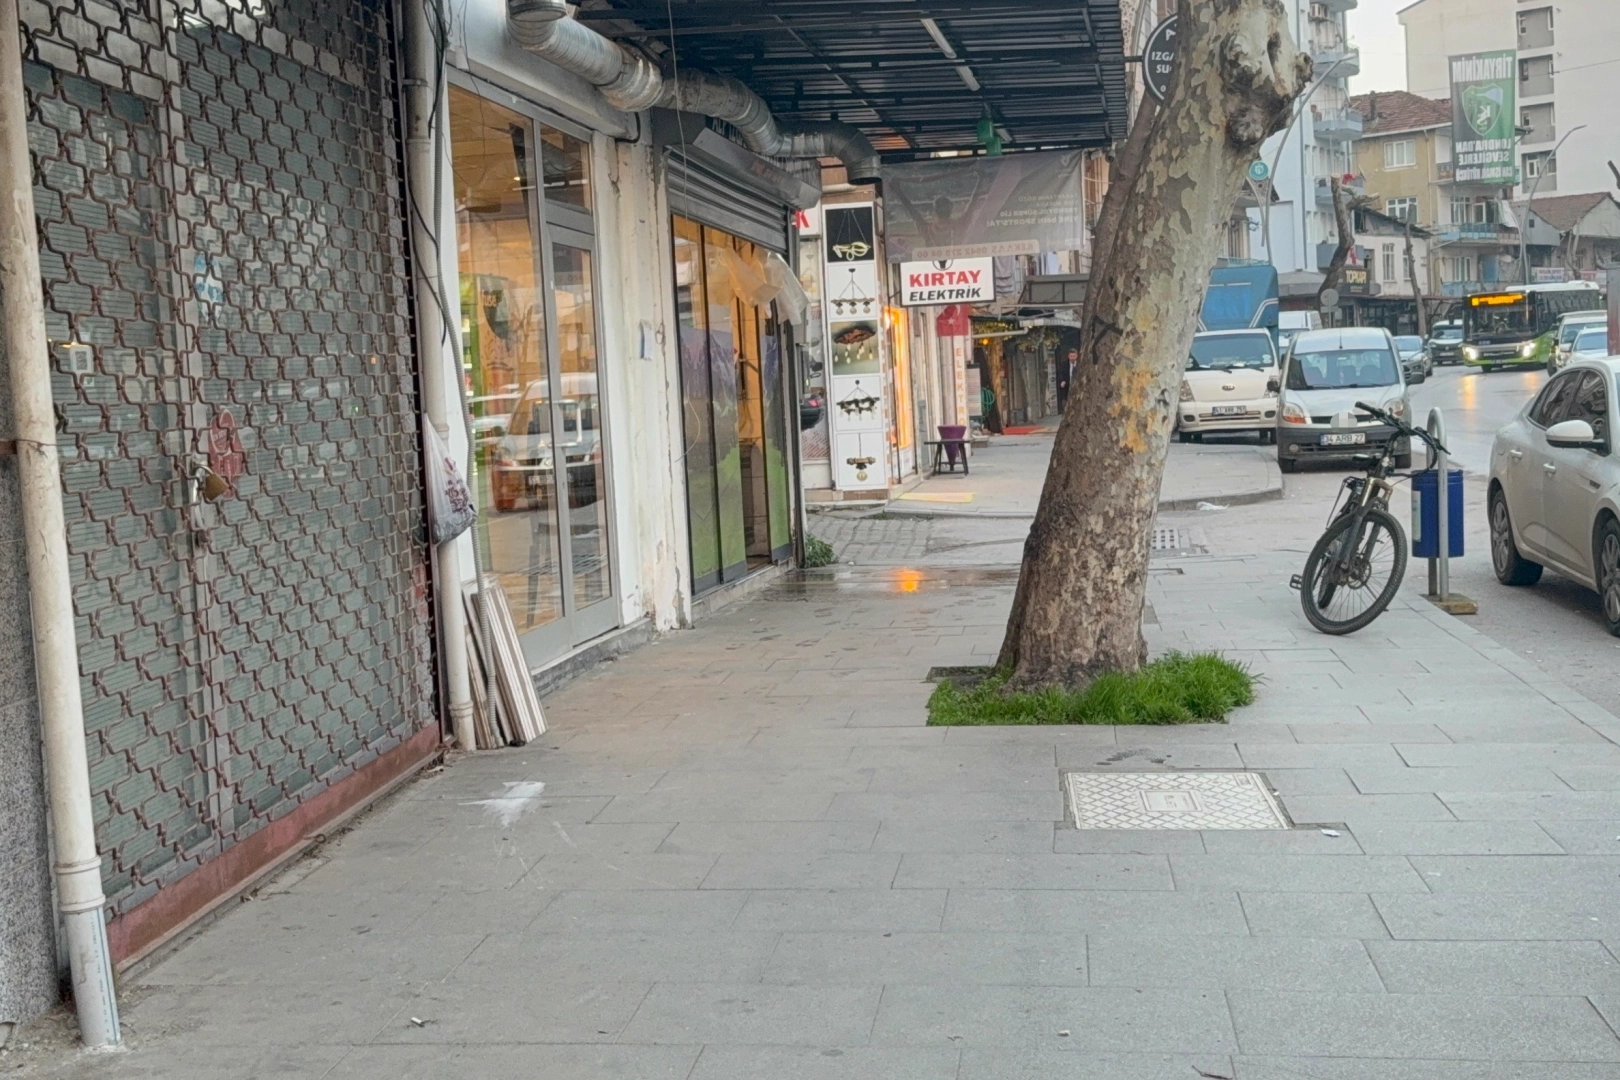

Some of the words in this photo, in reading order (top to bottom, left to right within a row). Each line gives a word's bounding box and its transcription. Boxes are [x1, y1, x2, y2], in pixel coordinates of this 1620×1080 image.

[1156, 64, 1172, 74] SU
[909, 269, 982, 288] KIRTAY
[909, 285, 982, 302] ELEKTRİK
[1325, 435, 1334, 443] 34
[1336, 434, 1353, 442] ARB
[1354, 433, 1364, 441] 27
